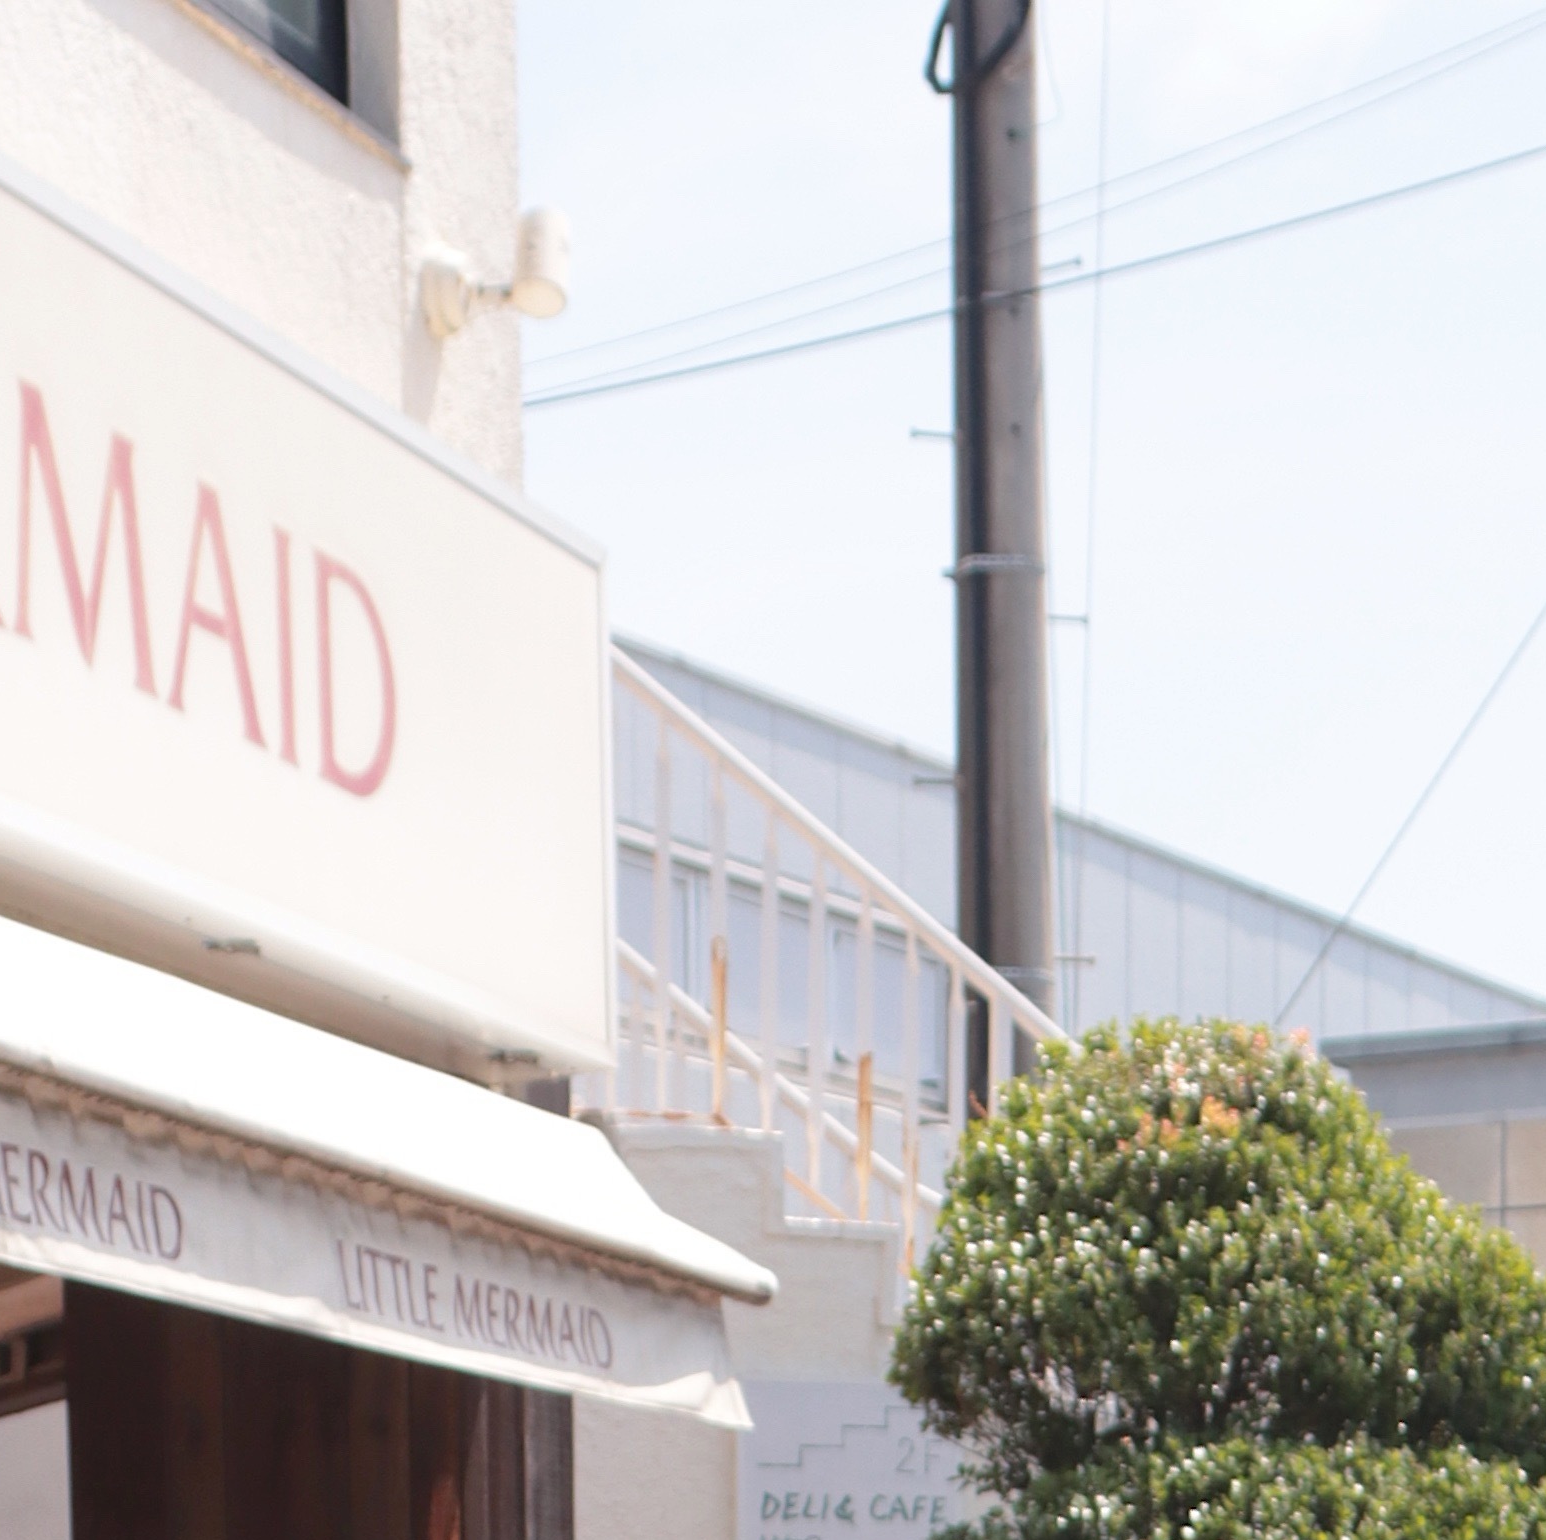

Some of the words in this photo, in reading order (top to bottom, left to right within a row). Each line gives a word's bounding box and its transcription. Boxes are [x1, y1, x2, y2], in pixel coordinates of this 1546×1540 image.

[335, 1239, 445, 1332] LITTLE
[454, 1273, 614, 1369] MERMAID
[896, 1436, 944, 1473] 2F
[870, 1493, 945, 1523] CAFE
